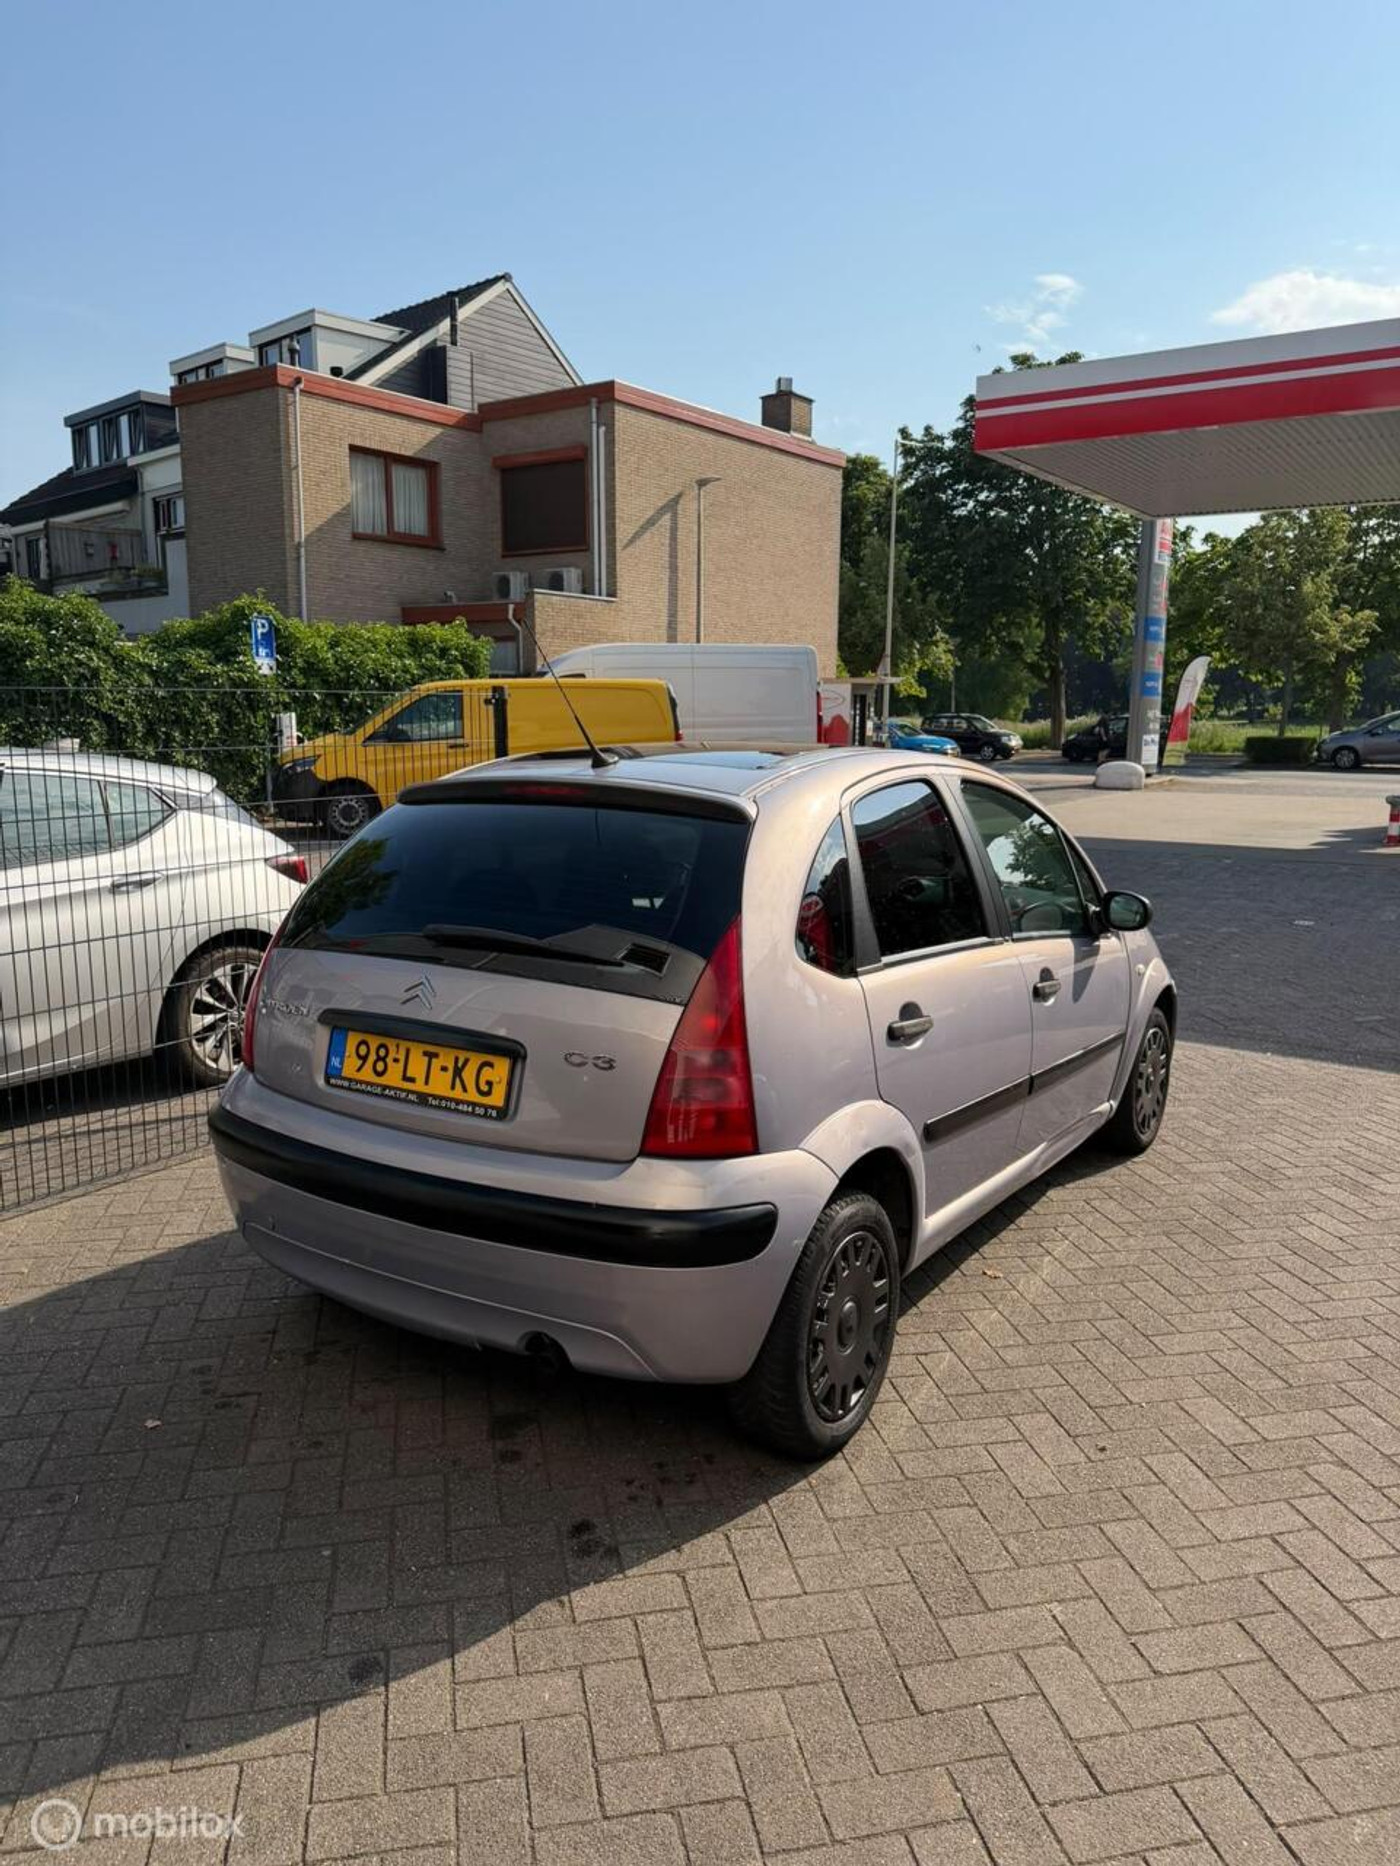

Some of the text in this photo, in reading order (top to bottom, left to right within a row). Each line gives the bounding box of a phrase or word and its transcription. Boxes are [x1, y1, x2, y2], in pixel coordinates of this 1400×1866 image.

[256, 618, 269, 639] P
[331, 1056, 342, 1068] NL
[355, 1039, 495, 1098] 98-LT-KG
[564, 1051, 617, 1071] C3
